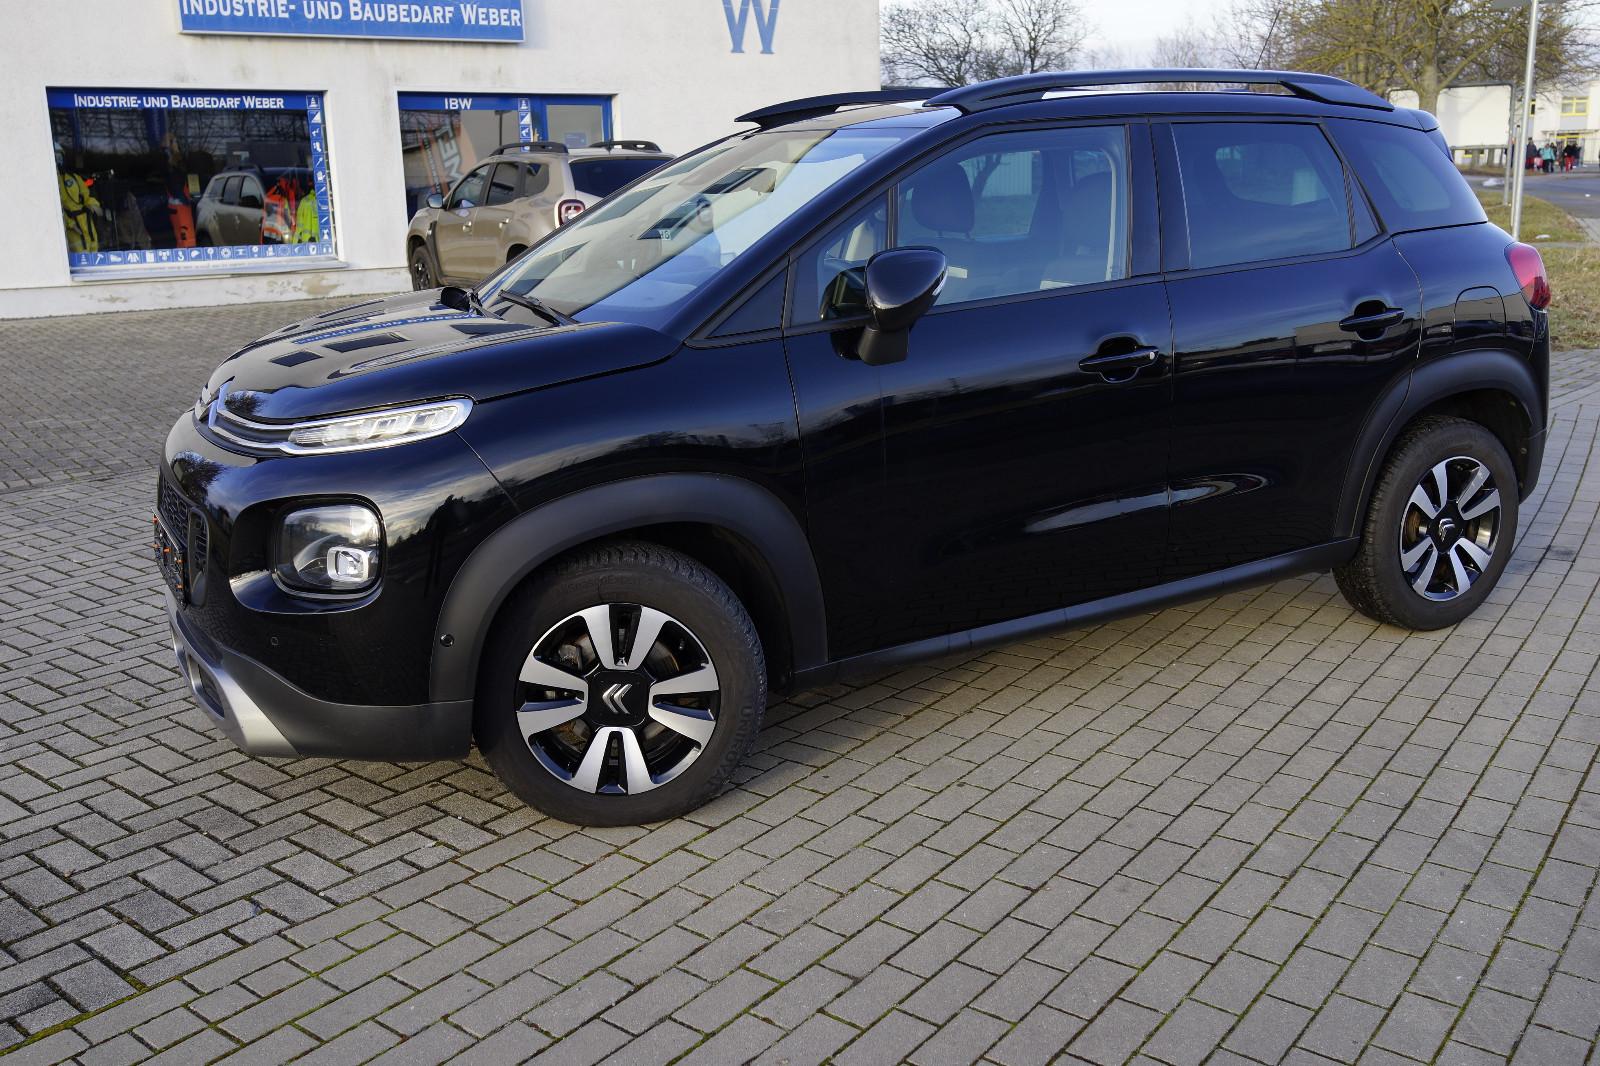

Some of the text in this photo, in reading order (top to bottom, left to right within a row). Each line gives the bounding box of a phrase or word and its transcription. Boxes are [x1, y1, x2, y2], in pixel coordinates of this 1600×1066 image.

[182, 0, 521, 27] INDUSTRIE- UND BAUBEDARF WEBER
[721, 0, 781, 54] W
[74, 93, 285, 109] INDUSTRIE- UND BAUBEDARF WEBER
[444, 97, 472, 110] IBW
